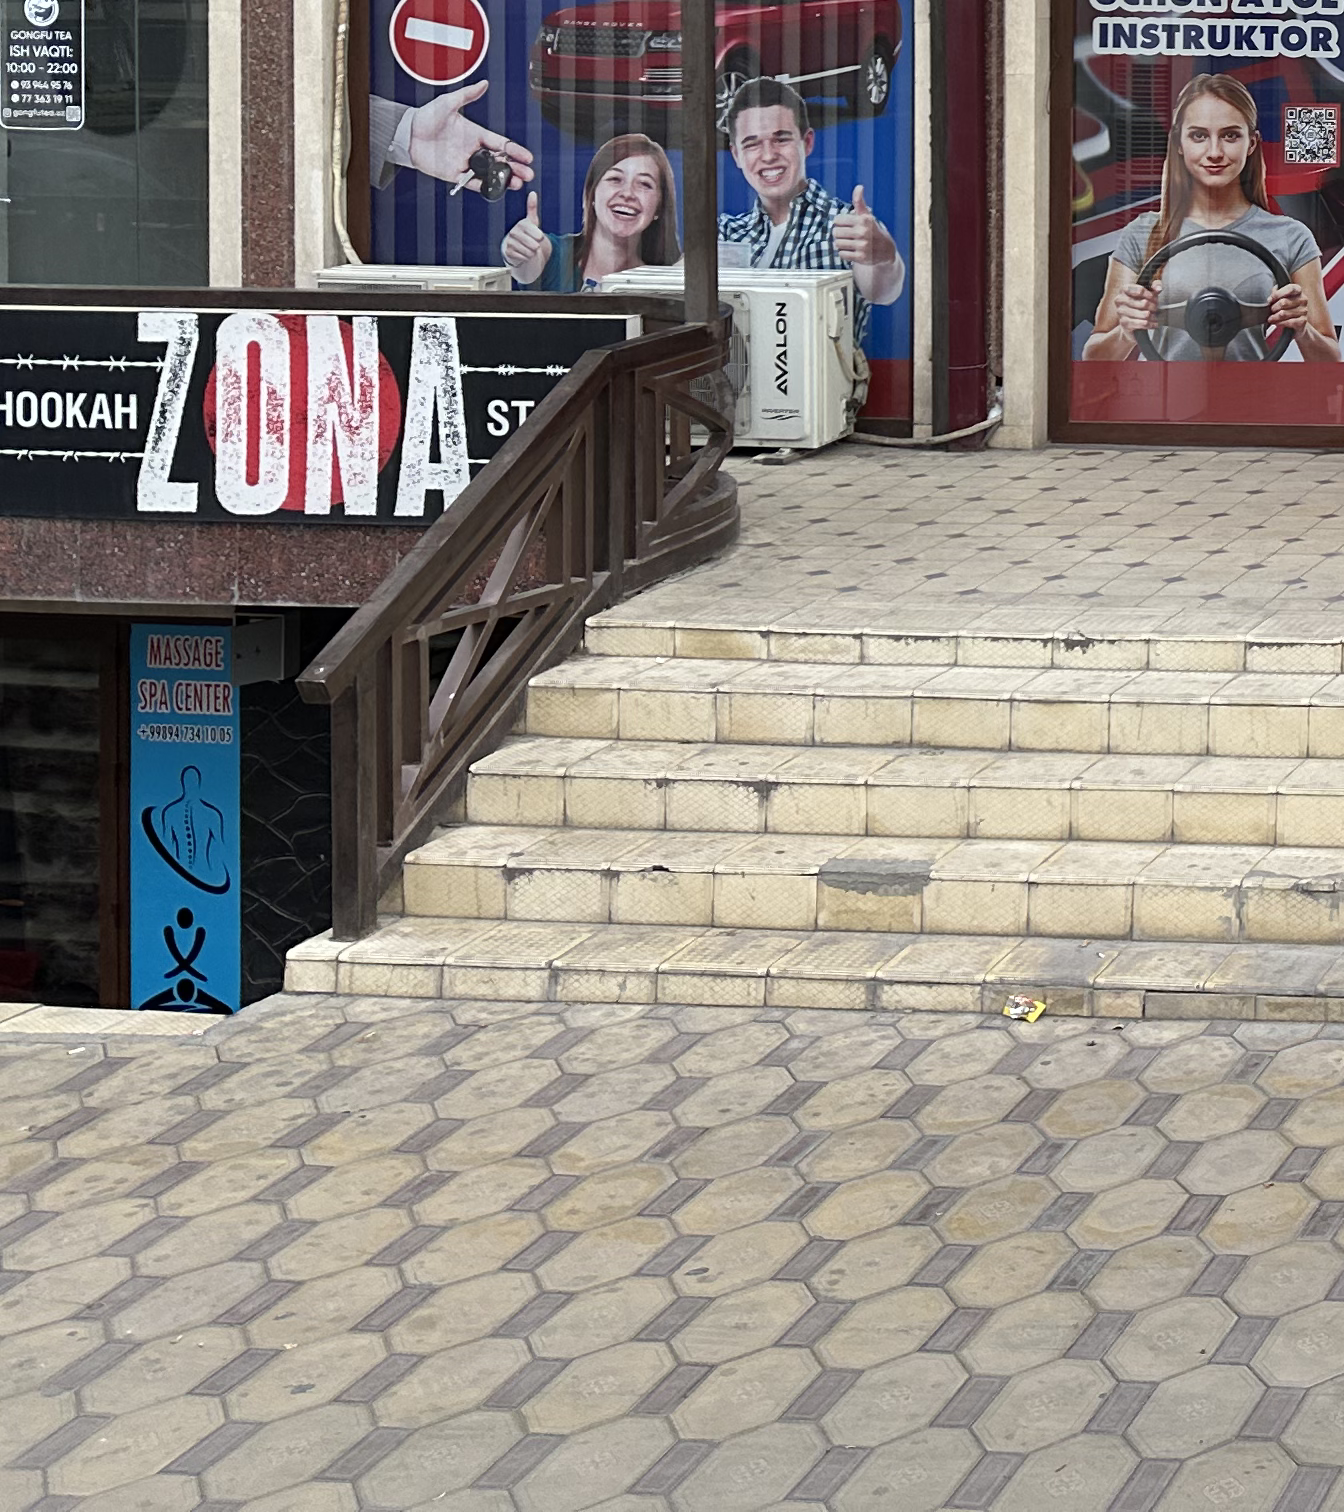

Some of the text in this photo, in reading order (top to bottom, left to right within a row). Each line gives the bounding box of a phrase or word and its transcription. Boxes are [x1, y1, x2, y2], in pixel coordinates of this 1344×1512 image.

[9, 44, 74, 58] ISH VAQTI:
[10, 30, 73, 41] GONGFU TEA
[1097, 23, 1336, 53] INSTRUKTOR
[6, 62, 36, 73] 10:00
[46, 62, 78, 74] 22:00
[774, 302, 788, 397] AVALON
[0, 391, 138, 430] HOOKAH
[137, 312, 471, 517] ZONA
[147, 635, 224, 670] MASSAGE
[138, 679, 232, 716] SPA CENTER
[181, 725, 202, 743] 734
[204, 726, 217, 744] 10
[218, 726, 232, 744] 05
